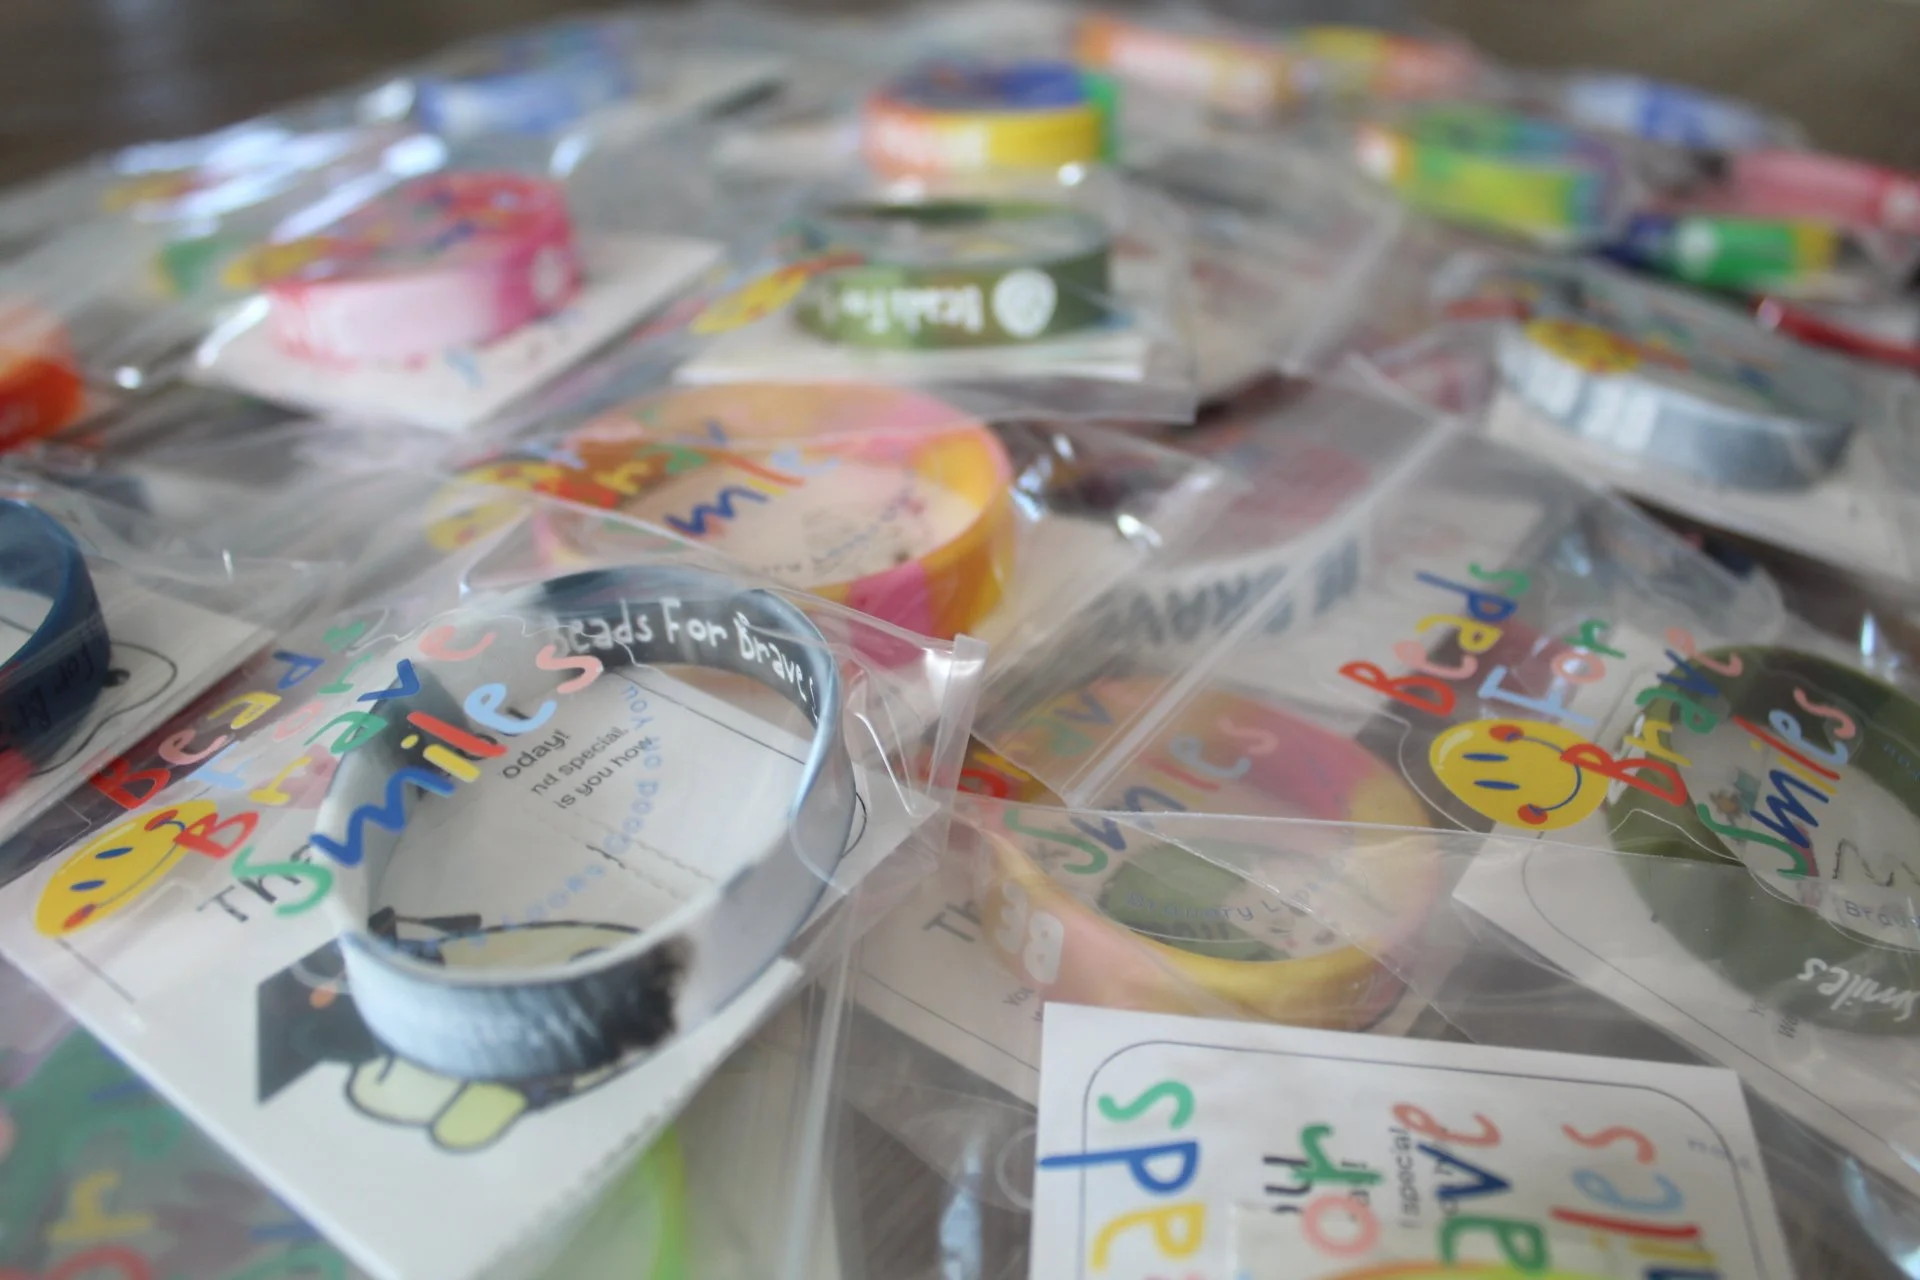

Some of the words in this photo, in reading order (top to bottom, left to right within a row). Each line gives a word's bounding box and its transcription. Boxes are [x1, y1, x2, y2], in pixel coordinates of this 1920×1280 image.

[658, 597, 728, 649] For
[732, 610, 808, 702] Brave
[1339, 562, 1530, 717] Beads
[1477, 618, 1626, 725] For
[1559, 627, 1743, 807] Brave
[229, 644, 604, 918] Smiles
[575, 768, 614, 798] you
[1003, 716, 1279, 876] Smiles
[1697, 687, 1857, 880] Smiles
[1797, 957, 1920, 1023] Smiles
